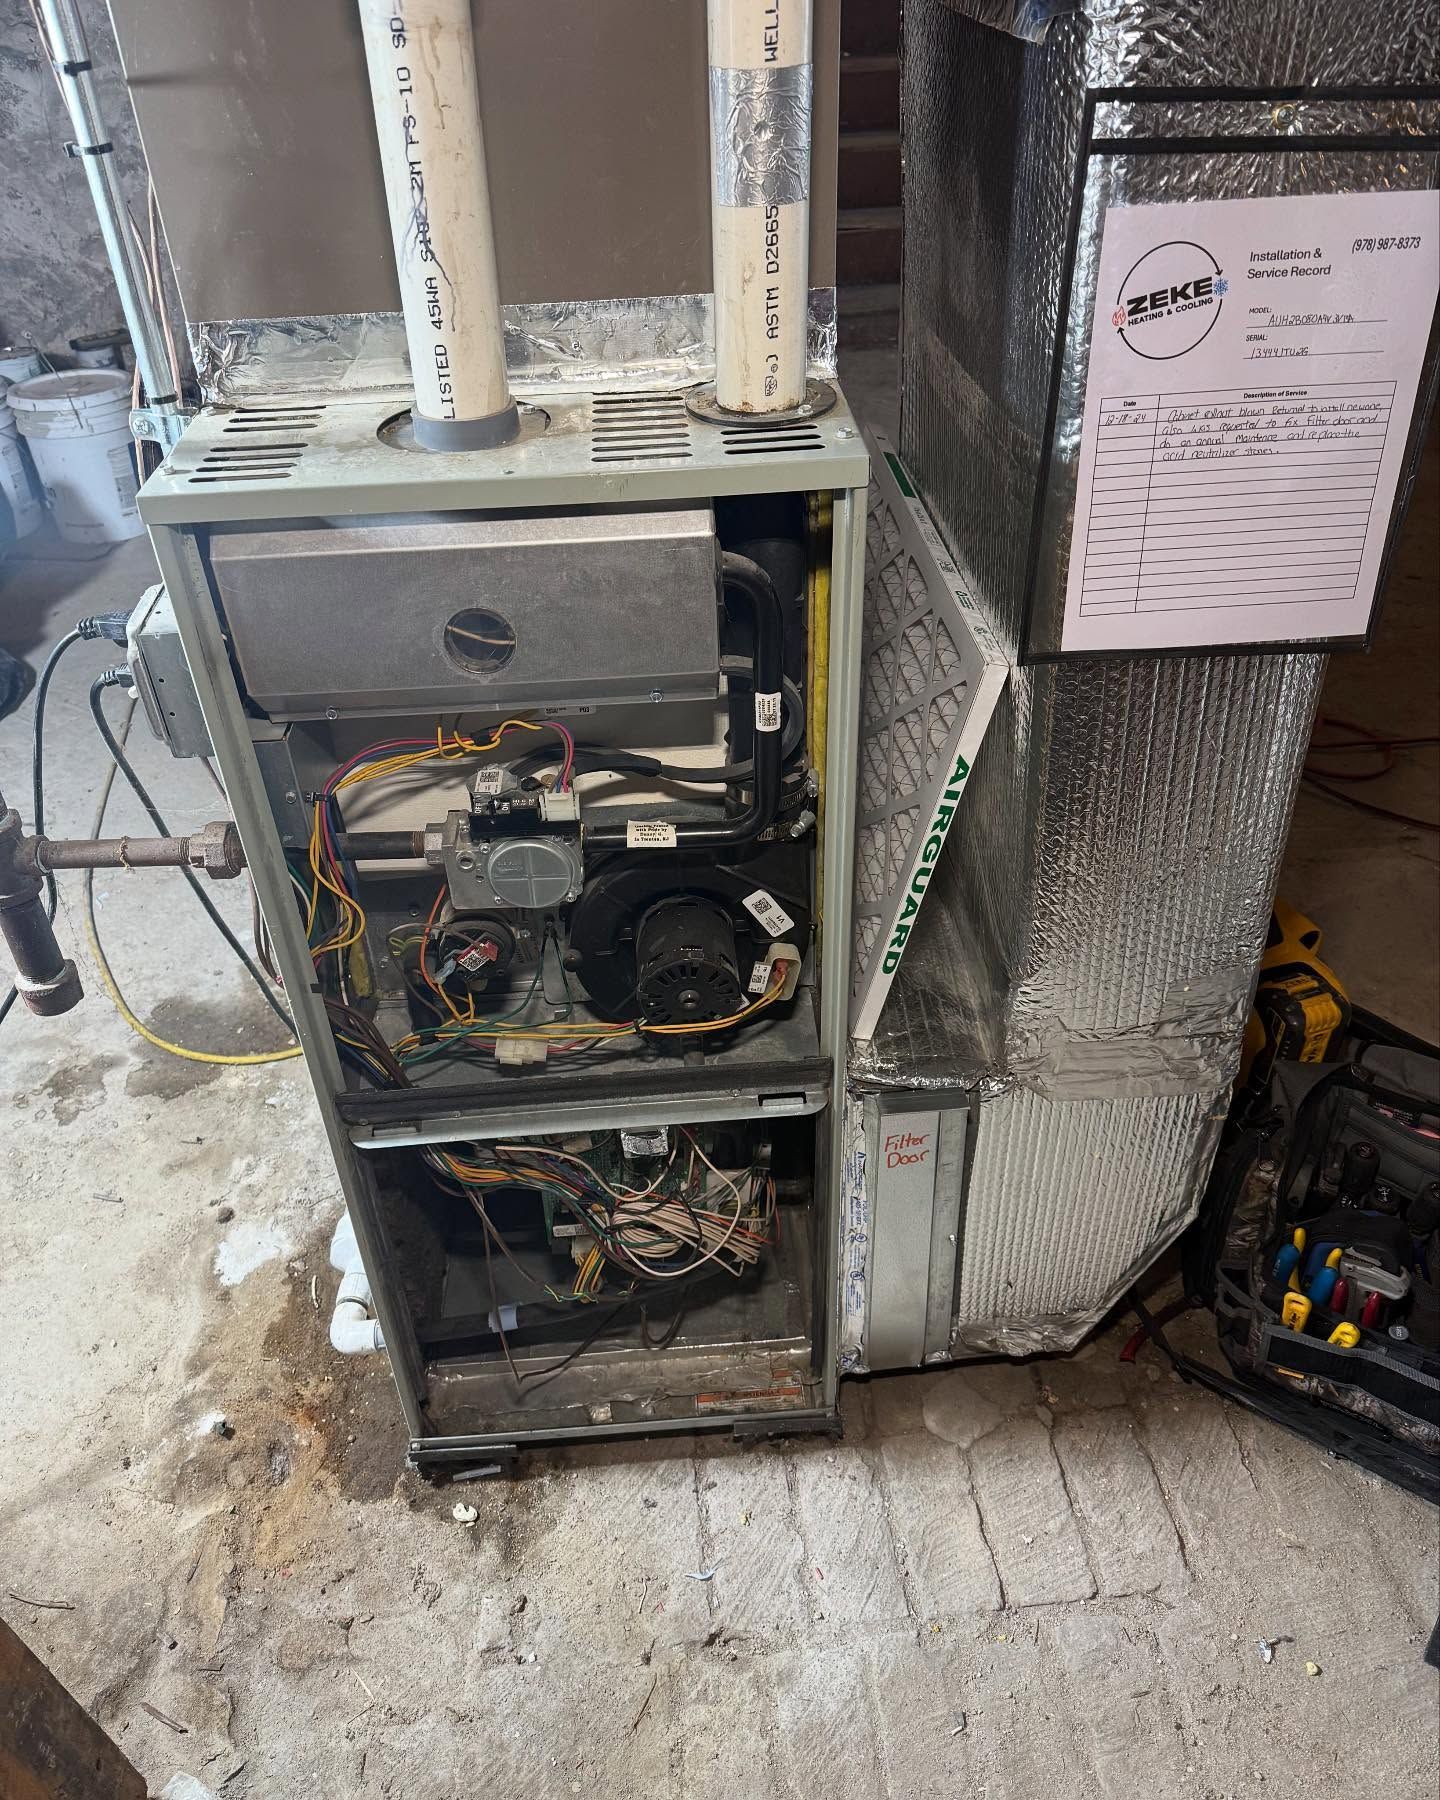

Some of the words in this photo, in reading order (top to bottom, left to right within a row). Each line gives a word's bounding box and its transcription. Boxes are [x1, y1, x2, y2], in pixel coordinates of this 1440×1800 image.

[765, 205, 779, 275] D2665
[1352, 237, 1376, 254] (978)
[1377, 236, 1421, 250] 987-8373
[1249, 249, 1311, 262] Installation
[1313, 248, 1322, 259] &
[1247, 266, 1288, 279] Service
[1290, 265, 1332, 277] Record
[1126, 276, 1213, 317] ZEKE
[766, 286, 779, 340] ASTM
[1127, 310, 1164, 327] HEATING
[1166, 308, 1173, 316] &
[1175, 297, 1214, 313] COOLING
[1246, 334, 1268, 342] SERIAL:
[434, 344, 456, 420] LISTED
[1243, 391, 1276, 399] Description
[882, 753, 971, 975] AIRGUARD
[884, 1132, 931, 1153] Filter
[887, 1149, 930, 1169] Door
